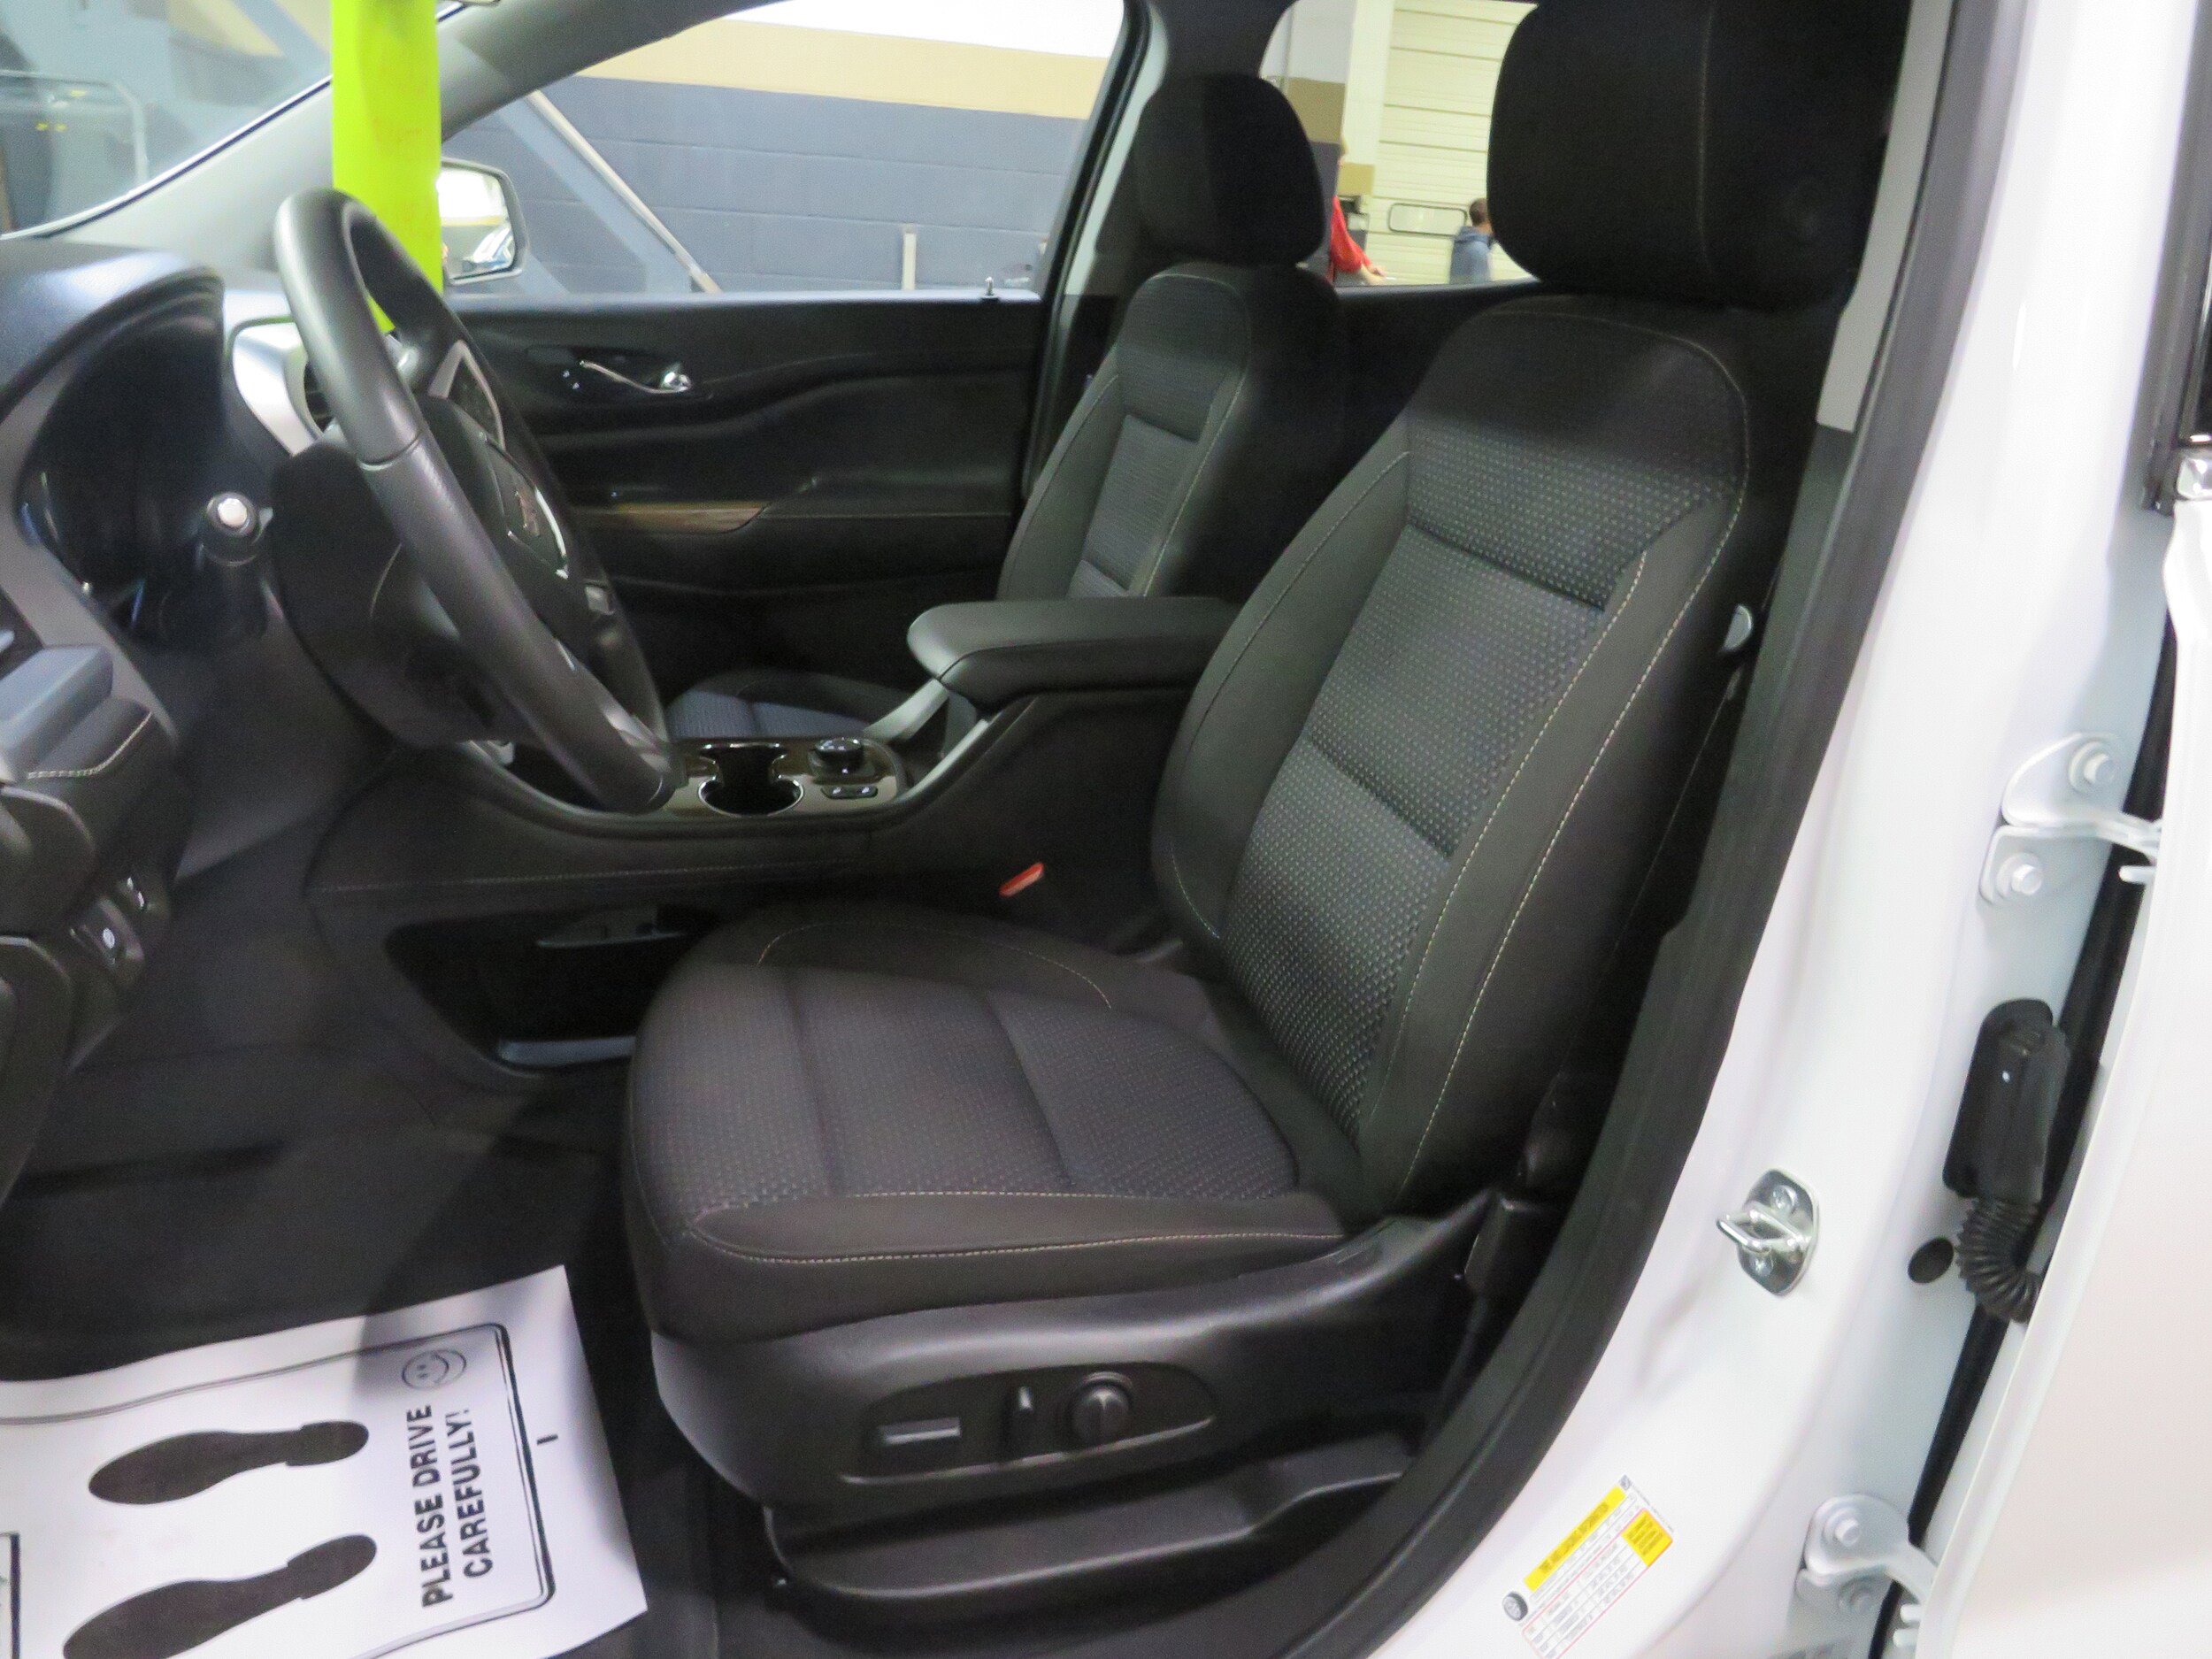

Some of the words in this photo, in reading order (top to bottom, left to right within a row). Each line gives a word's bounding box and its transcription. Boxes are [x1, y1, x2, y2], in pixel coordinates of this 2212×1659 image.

[406, 1404, 441, 1487] DRIVE
[445, 1409, 493, 1578] CAREFULLY!
[414, 1494, 453, 1607] PLEASE
